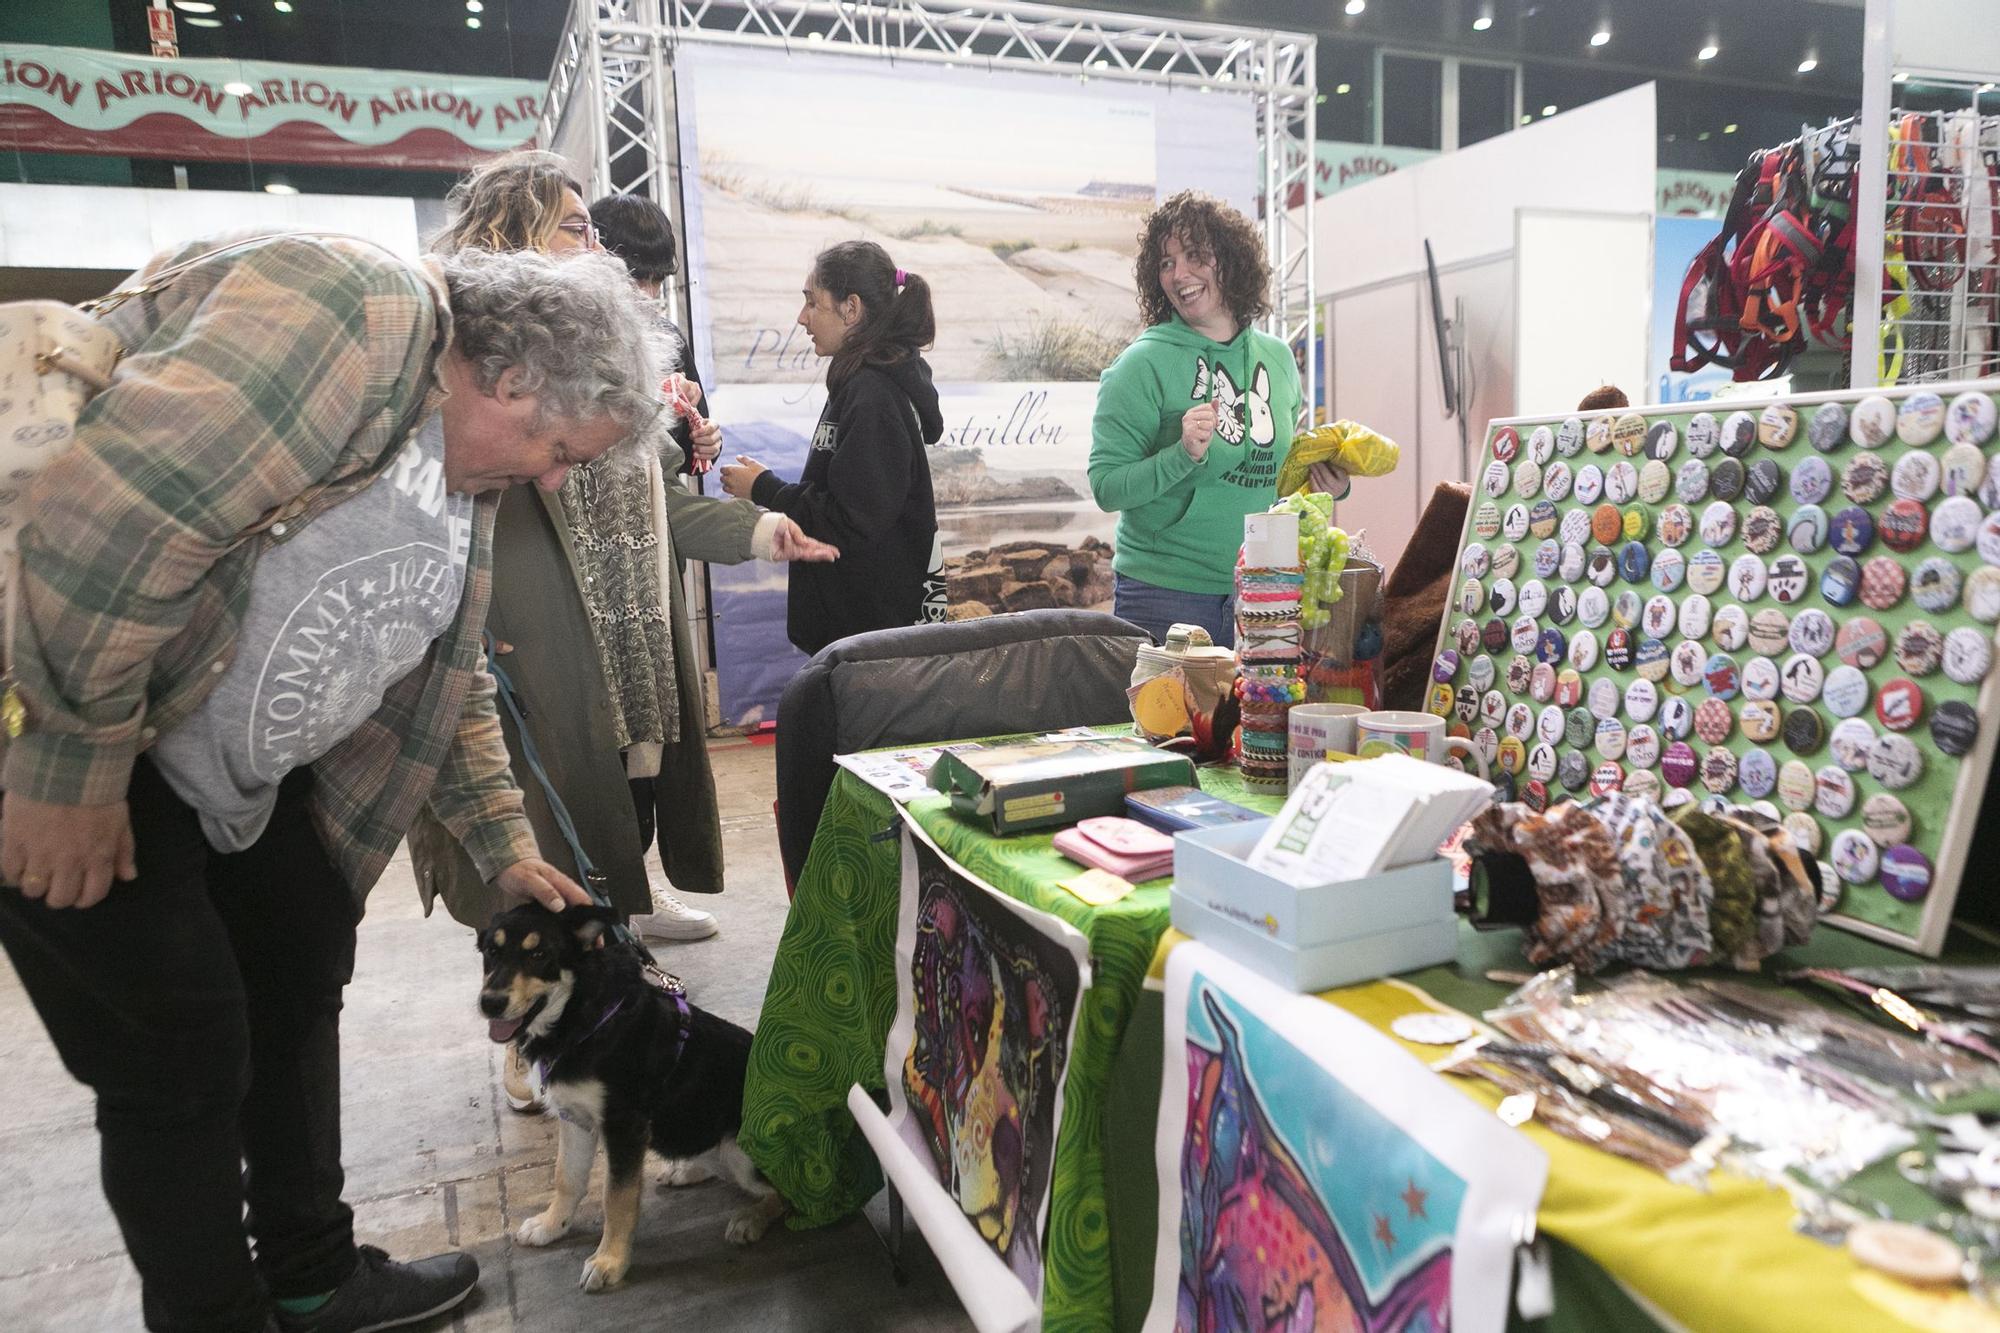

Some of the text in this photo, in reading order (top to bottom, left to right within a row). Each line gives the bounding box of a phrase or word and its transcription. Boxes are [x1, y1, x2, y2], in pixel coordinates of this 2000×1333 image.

[1, 58, 82, 107] ION
[94, 67, 226, 115] ARION
[238, 78, 358, 123] ARION
[369, 86, 483, 130] ARION
[1250, 448, 1273, 461] Alma
[264, 579, 355, 749] TOMMY
